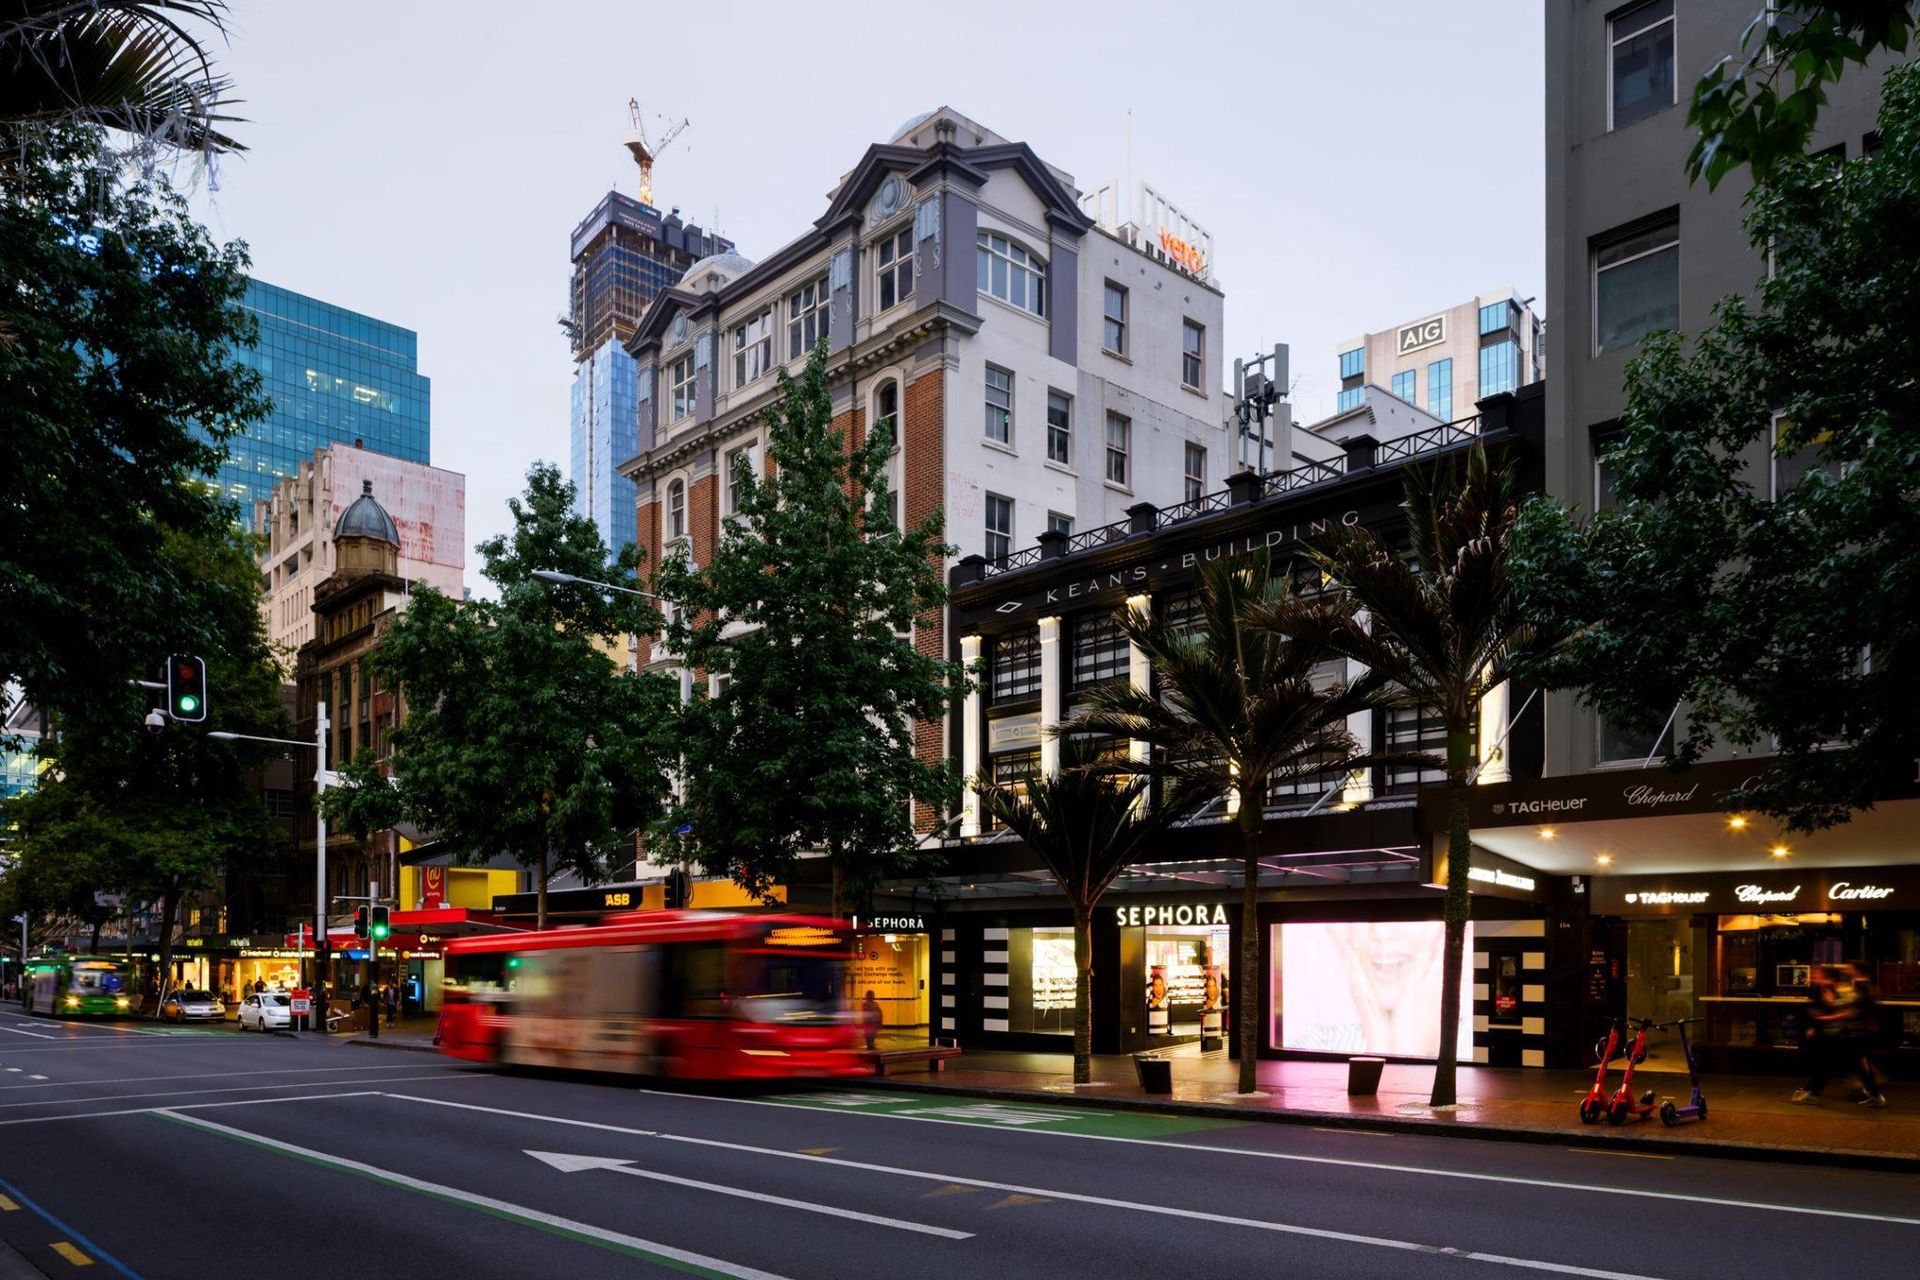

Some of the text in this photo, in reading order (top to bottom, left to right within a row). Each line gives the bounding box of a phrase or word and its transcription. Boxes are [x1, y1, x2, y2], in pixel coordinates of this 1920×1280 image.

[1161, 224, 1202, 273] vero
[1403, 322, 1441, 349] AIG
[1046, 510, 1359, 604] KEAN'S BUILDING
[1623, 783, 1700, 808] Chopard
[605, 893, 630, 906] ASB
[1734, 884, 1801, 905] Chopard
[1828, 882, 1895, 901] Cartier
[1116, 903, 1227, 927] SEPHORA
